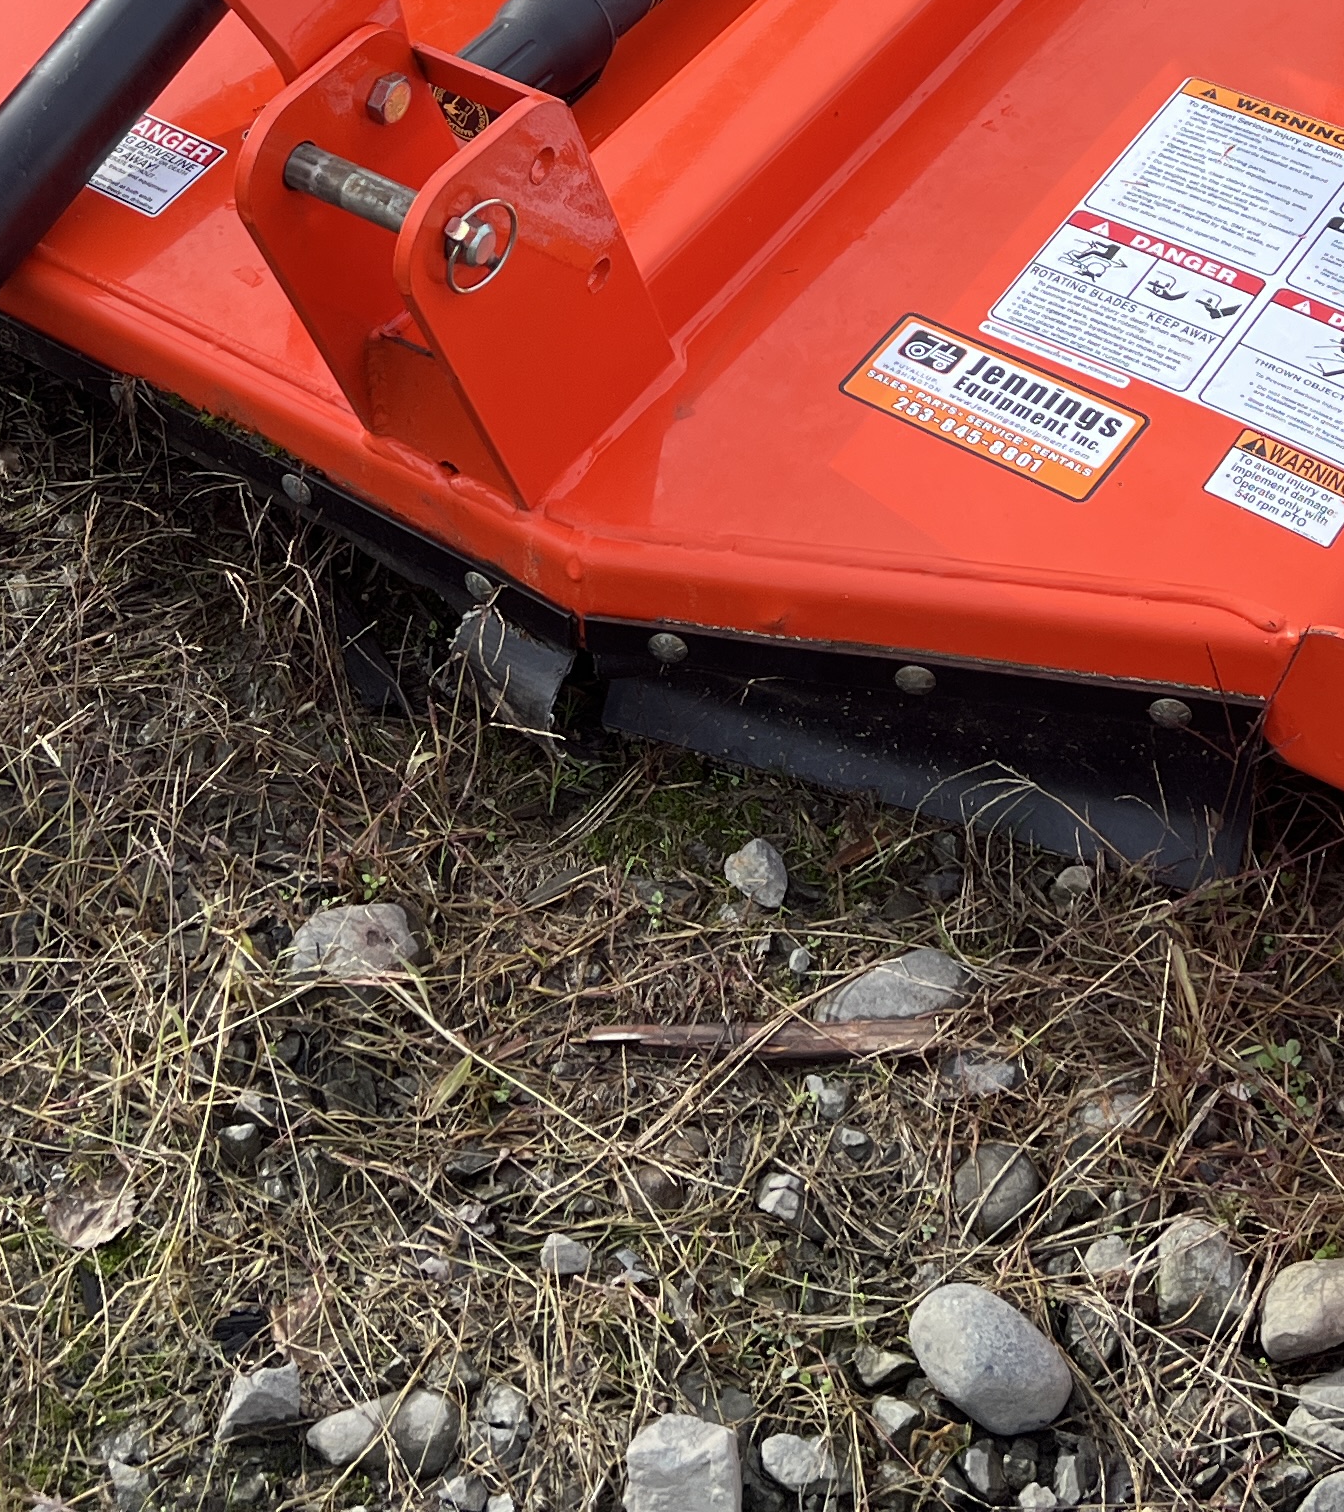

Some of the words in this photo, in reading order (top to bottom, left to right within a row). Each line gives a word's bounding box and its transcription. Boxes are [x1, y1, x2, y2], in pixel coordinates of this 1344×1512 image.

[119, 148, 160, 173] AWAY!
[130, 116, 215, 163] ANGER
[133, 139, 198, 173] DRIVELINE
[1128, 233, 1239, 285] DANGER
[1028, 265, 1089, 294] ROTATING
[1087, 288, 1138, 314] BLADES
[1144, 311, 1180, 331] KEEP
[1179, 324, 1217, 345] AWAY
[880, 362, 942, 393] WASHINGTON
[1252, 356, 1302, 383] THROWN
[864, 368, 910, 394] SALES
[913, 390, 959, 416] PARTS
[963, 413, 1025, 446] SERVICE
[1027, 442, 1095, 478] RENTALS
[950, 374, 1076, 439] Equipment,
[1068, 429, 1107, 454] Inc.
[963, 353, 1128, 442] Jennings
[889, 394, 1046, 474] 253-845-8801
[946, 391, 1092, 461] www.jenningsequipment.com
[1229, 461, 1291, 496] implement
[1287, 489, 1341, 520] damage:
[1229, 474, 1278, 503] Operate
[1274, 495, 1305, 515] only
[1302, 508, 1330, 526] with
[1236, 452, 1255, 466] To
[1252, 459, 1287, 481] avoid
[1283, 475, 1321, 499] injury
[1318, 491, 1335, 504] or
[1233, 487, 1257, 504] 540
[1254, 498, 1281, 517] rpm
[1280, 509, 1308, 528] PTO
